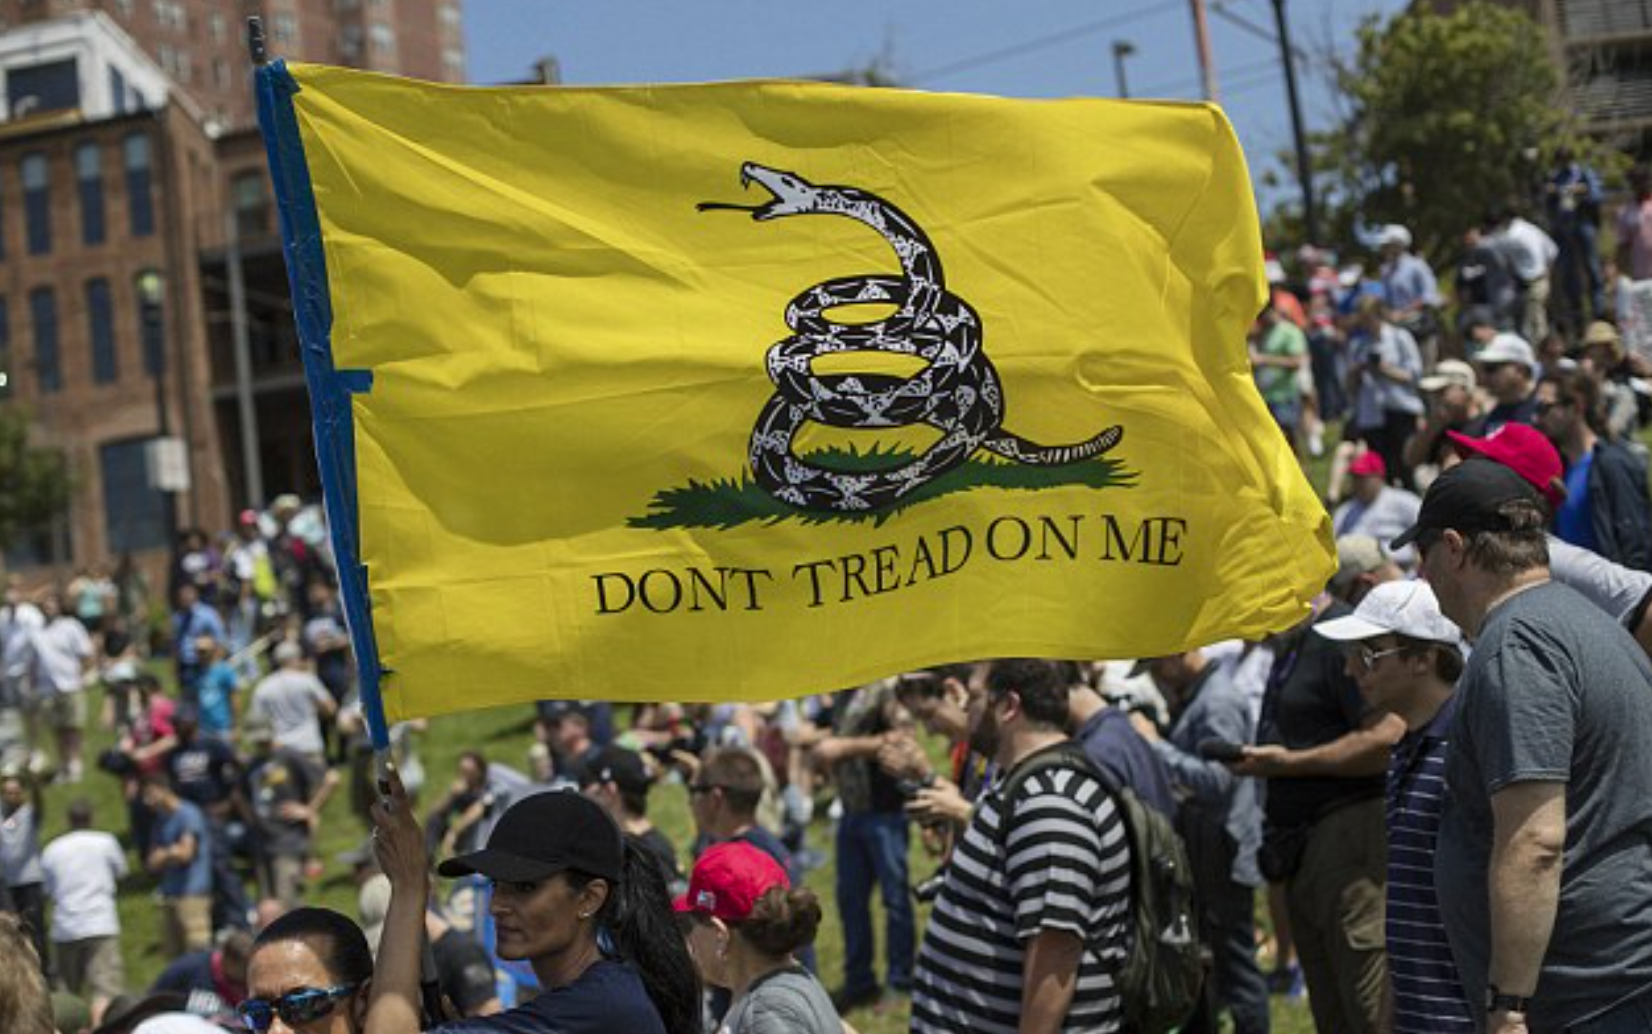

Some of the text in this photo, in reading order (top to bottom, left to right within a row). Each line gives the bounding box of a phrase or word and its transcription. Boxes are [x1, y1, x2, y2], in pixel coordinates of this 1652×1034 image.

[590, 514, 1188, 615] DONT TREAD ON ME
